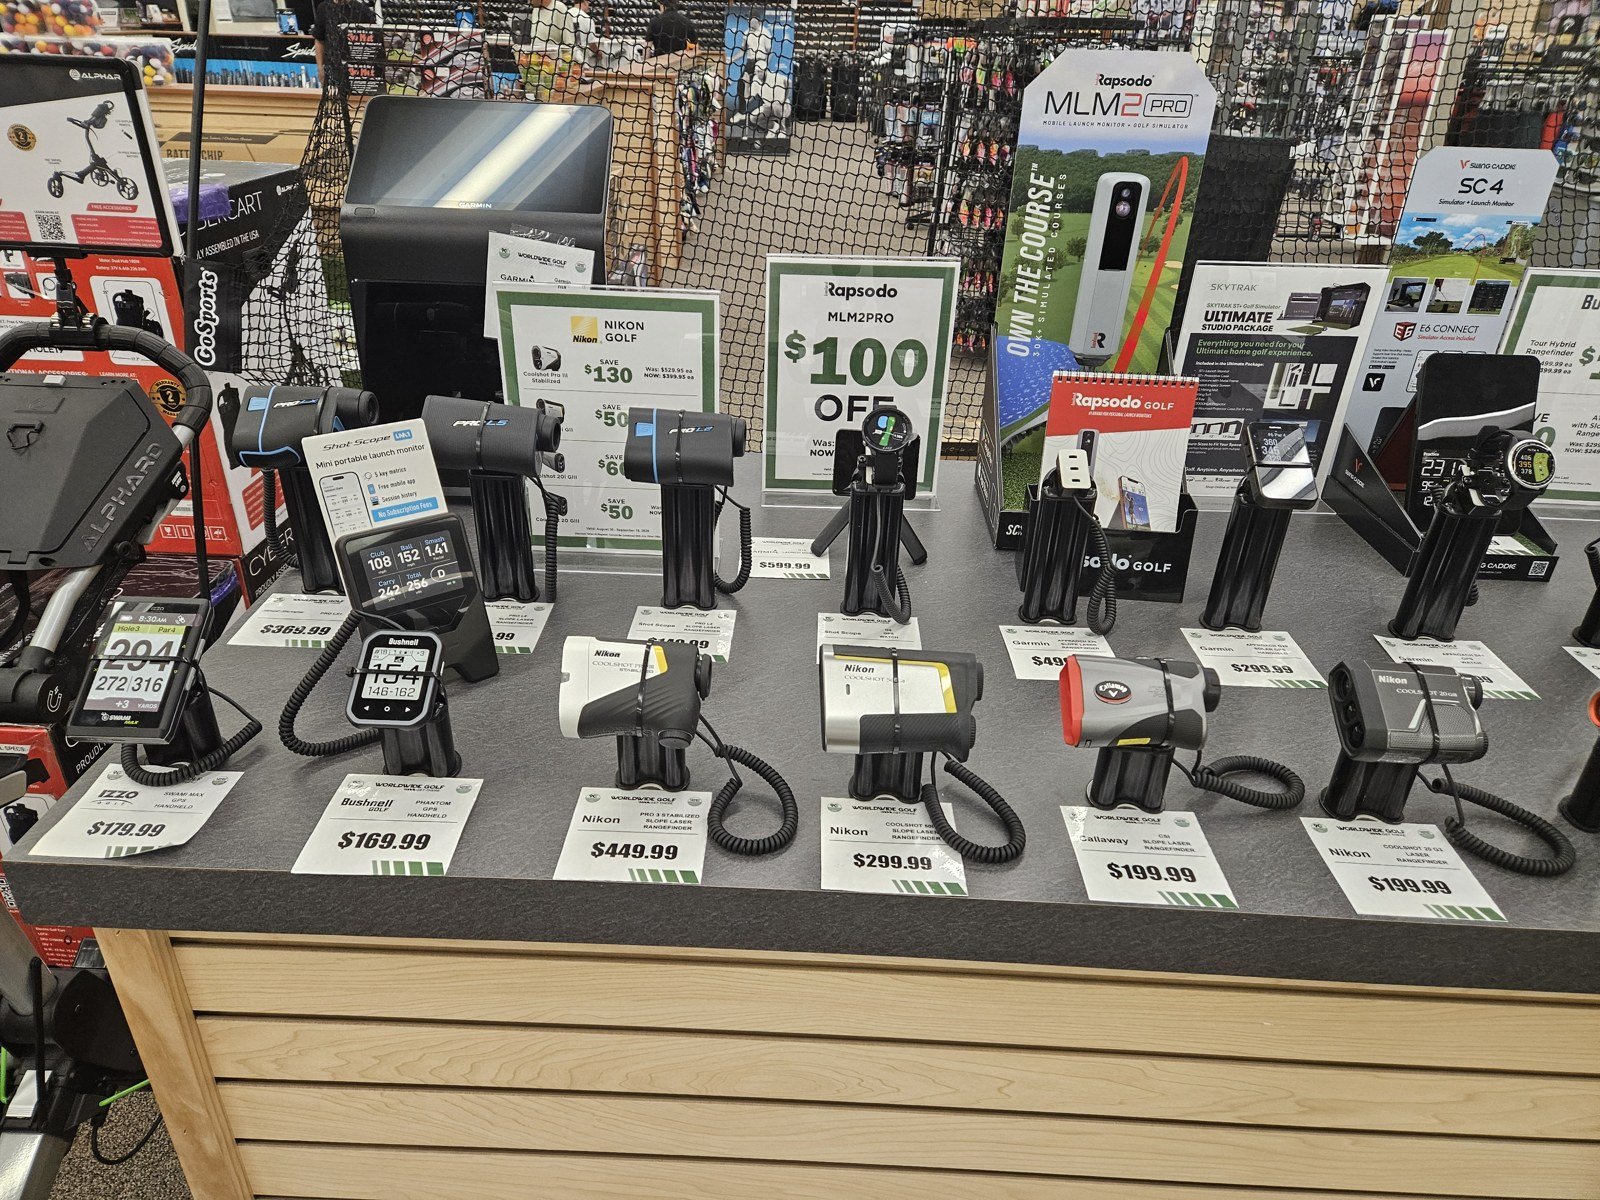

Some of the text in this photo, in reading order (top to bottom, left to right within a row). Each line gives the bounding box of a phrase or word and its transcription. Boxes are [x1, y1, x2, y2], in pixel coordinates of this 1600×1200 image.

[1097, 73, 1154, 90] Rapsodo
[1044, 90, 1188, 117] MLM2 PRO
[1438, 198, 1515, 208] Simulator Launch Monitor
[1038, 247, 1057, 323] SIMULATED
[1050, 174, 1068, 238] COURSES
[517, 251, 568, 266] WORLDWIDE GOLF
[1013, 264, 1042, 305] THE
[1210, 283, 1257, 292] SKYTRAK
[825, 281, 898, 301] Rapsodo
[194, 268, 218, 367] GoSports
[827, 311, 895, 324] MLM2PRO
[1203, 310, 1274, 323] ULTIMATE
[603, 320, 645, 332] NIKON
[1201, 323, 1274, 332] STUDIO PACKAGE
[1394, 324, 1416, 339] E6
[1420, 324, 1480, 334] E6 CONNECT
[572, 334, 599, 344] Nikon
[604, 332, 638, 343] GOLF
[1006, 309, 1036, 357] OWN
[1197, 339, 1240, 348] Everything
[1240, 341, 1255, 349] you
[1274, 341, 1287, 349] for
[1287, 342, 1306, 350] your
[1530, 339, 1576, 350] Tour Hybrid
[1196, 347, 1314, 357] Ultimate home golf experience.
[1525, 348, 1574, 358] Rangefinder
[599, 358, 619, 366] SAVE
[784, 329, 928, 388] $100
[523, 371, 550, 379] Coolshot
[584, 363, 633, 384] $130
[660, 366, 685, 374] $529.95
[531, 377, 561, 385] Stabilized
[1072, 391, 1175, 411] Rapsodo GOLF
[595, 409, 629, 428] $50
[1571, 421, 1590, 429] with
[322, 434, 391, 452] Shot Scope
[315, 443, 425, 470] Mini portable launch monitor
[604, 453, 623, 461] SAVE
[1518, 460, 1532, 468] 395
[377, 478, 416, 491] Free mobile app
[81, 441, 163, 551] ALPHARD
[381, 491, 418, 503] Session history
[377, 500, 433, 519] No Subscription Fees
[600, 502, 634, 520] $50
[370, 536, 445, 559] Club Ball Smash
[367, 541, 449, 571] 108 152 1.41
[759, 561, 811, 570] $599.99
[1132, 561, 1172, 574] GOLF
[378, 569, 446, 588] Carry Total D
[378, 577, 429, 599] 242 256
[260, 624, 332, 636] $369.99
[388, 637, 419, 646] Bushnell
[103, 638, 174, 672] 294
[594, 649, 621, 658] Nikon
[592, 660, 634, 669] COOLSHOT
[844, 664, 876, 674] Nikon
[1231, 663, 1294, 674] $299.99
[372, 663, 420, 685] 154
[844, 675, 885, 683] COOLSHOT
[1378, 675, 1408, 685] Nikon
[95, 675, 164, 693] 272 316
[368, 686, 416, 698] 146-162
[115, 699, 129, 709] +3
[375, 781, 423, 790] WORLDWIDE
[98, 789, 139, 800] IZZO
[610, 795, 656, 804] WORLDWIDE
[340, 797, 394, 808] Bushnell
[851, 804, 897, 813] WORLDWIDE
[581, 814, 622, 825] Nikon
[1093, 814, 1162, 825] WORLDWIDE GOLF
[86, 820, 167, 838] $179.99
[829, 826, 869, 837] Nikon
[1336, 824, 1406, 836] WORLDWIDE GOLF
[337, 831, 432, 851] $169.99
[1079, 834, 1129, 846] Callaway
[590, 842, 679, 861] $449.99
[1144, 845, 1196, 853] RANGEFINDER
[1328, 847, 1372, 859] Nikon
[1383, 843, 1423, 851] COOLSHOT
[853, 852, 933, 870] $299.99
[1396, 857, 1449, 865] RANGEFINDER
[1106, 862, 1198, 883] $199.99
[1368, 874, 1452, 895] $199.99
